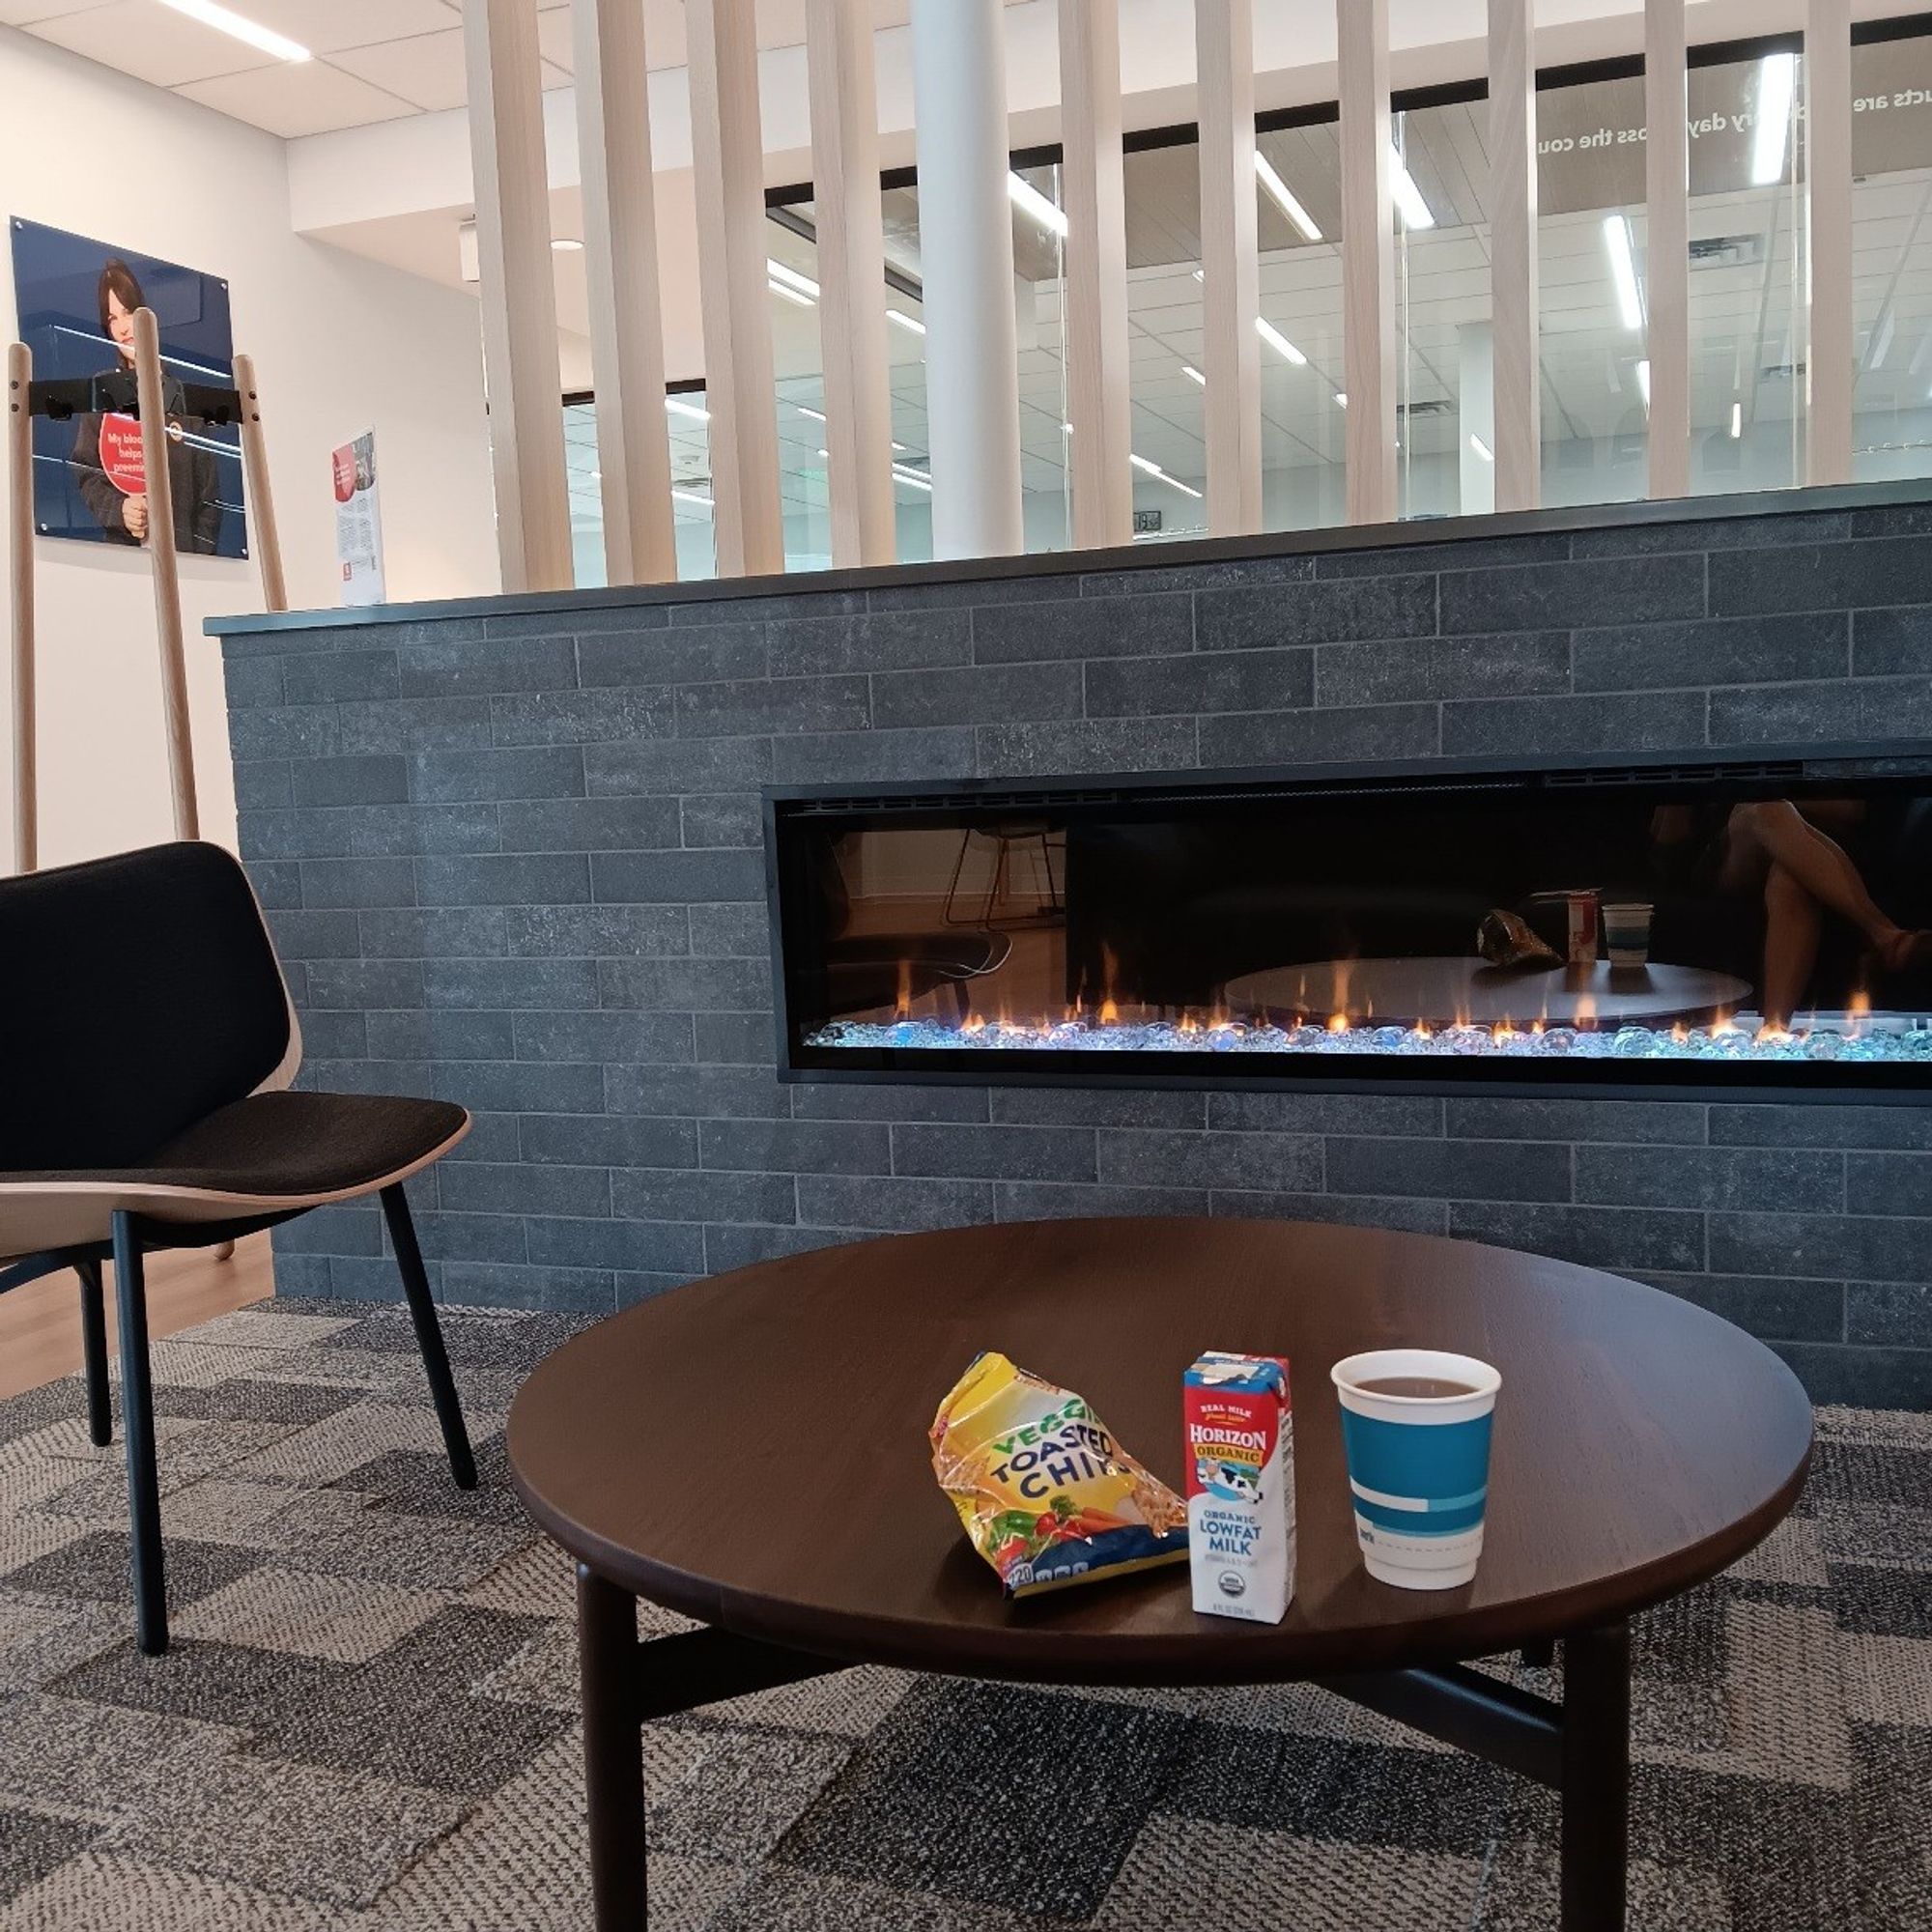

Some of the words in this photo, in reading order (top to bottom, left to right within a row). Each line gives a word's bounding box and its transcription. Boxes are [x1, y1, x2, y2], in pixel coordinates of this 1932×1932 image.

[123, 433, 144, 444] bloo
[1200, 1404, 1225, 1413] REAL
[1228, 1405, 1252, 1418] MILK
[1189, 1423, 1266, 1450] HORIZON
[990, 1423, 1114, 1484] TOASTED
[1196, 1445, 1261, 1463] ORGANIC
[1203, 1509, 1256, 1525] ORGANIC
[1200, 1520, 1262, 1540] LOWFAT
[1209, 1537, 1252, 1556] MILK
